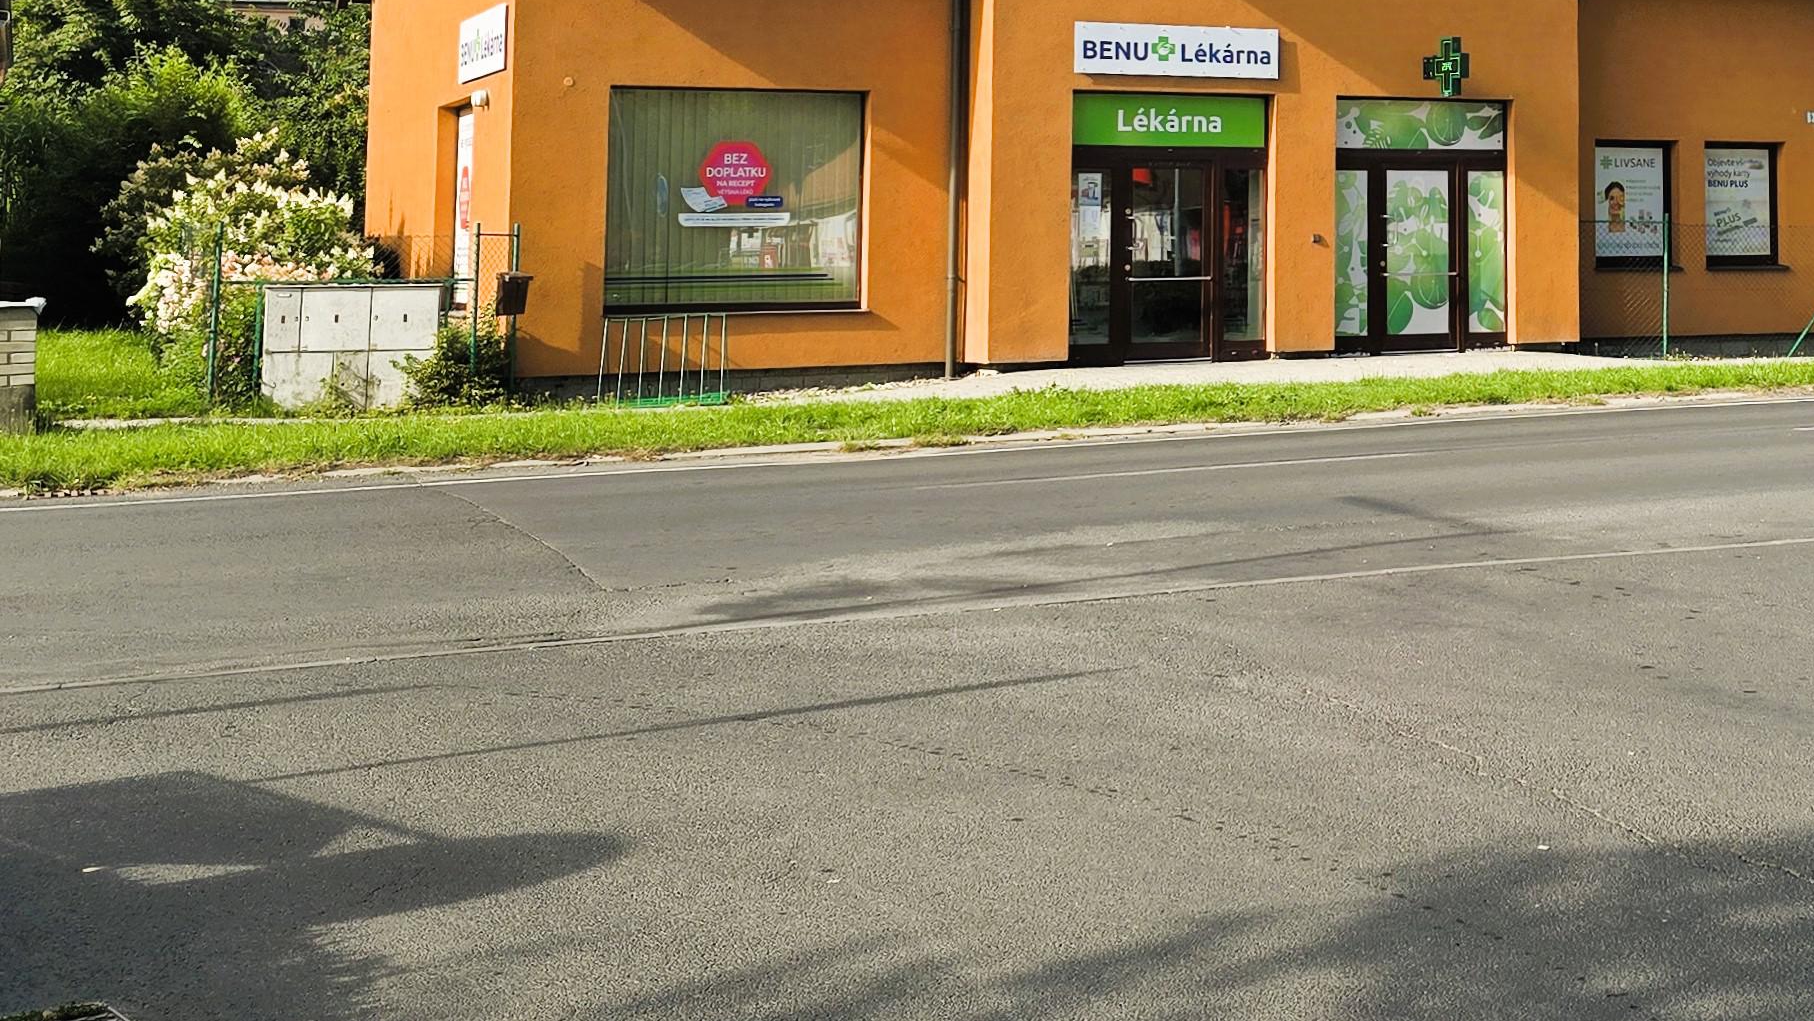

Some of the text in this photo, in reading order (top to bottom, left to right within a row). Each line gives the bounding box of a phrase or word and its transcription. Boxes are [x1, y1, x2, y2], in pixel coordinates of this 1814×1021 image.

[1082, 40, 1271, 65] BENU Lékárna
[1117, 108, 1222, 133] Lékárna
[723, 153, 748, 165] BEZ
[1614, 158, 1656, 168] LIVSANE
[706, 167, 767, 178] DOPLATKU
[1707, 180, 1749, 188] BENU PLUS
[1716, 212, 1741, 228] PLUS
